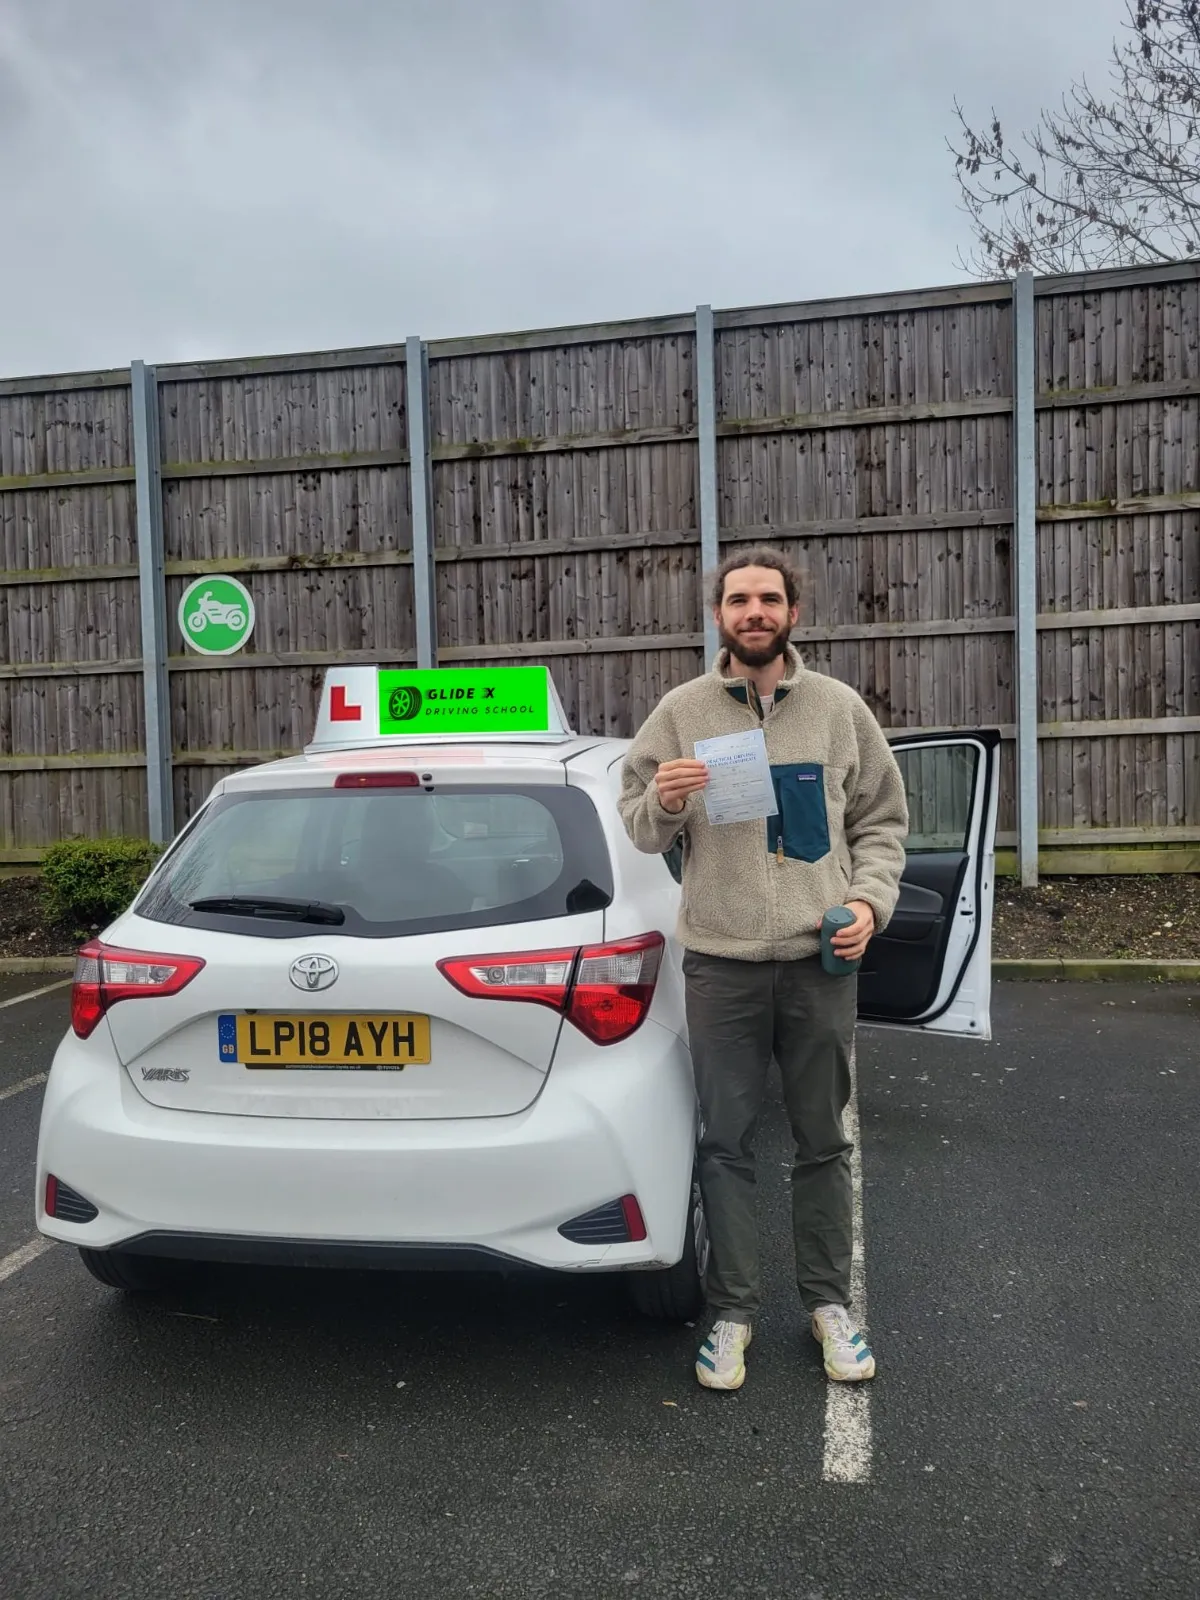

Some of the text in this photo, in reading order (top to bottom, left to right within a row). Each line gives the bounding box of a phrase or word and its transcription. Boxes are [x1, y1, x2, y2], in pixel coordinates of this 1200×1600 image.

[427, 687, 496, 700] GLIDE X
[330, 686, 361, 721] L
[425, 705, 534, 716] DRIVING SCHOOL
[250, 1021, 415, 1057] LP18 AYH
[222, 1044, 235, 1054] GB
